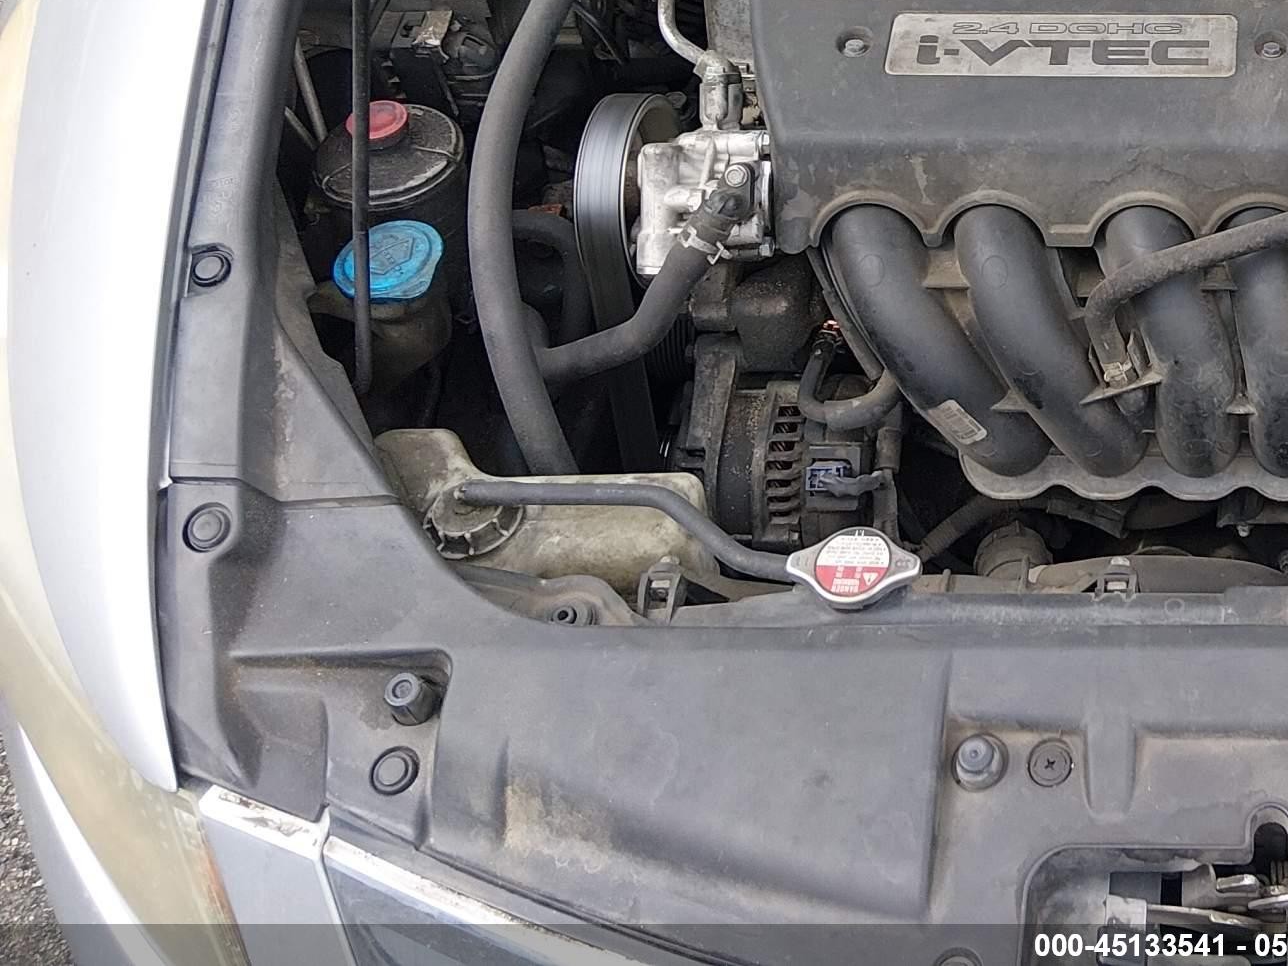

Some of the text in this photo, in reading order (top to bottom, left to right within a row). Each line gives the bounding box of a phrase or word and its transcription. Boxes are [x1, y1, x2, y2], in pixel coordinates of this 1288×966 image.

[952, 21, 1183, 35] 2.4 DOHC
[916, 34, 1210, 67] i-VTEC
